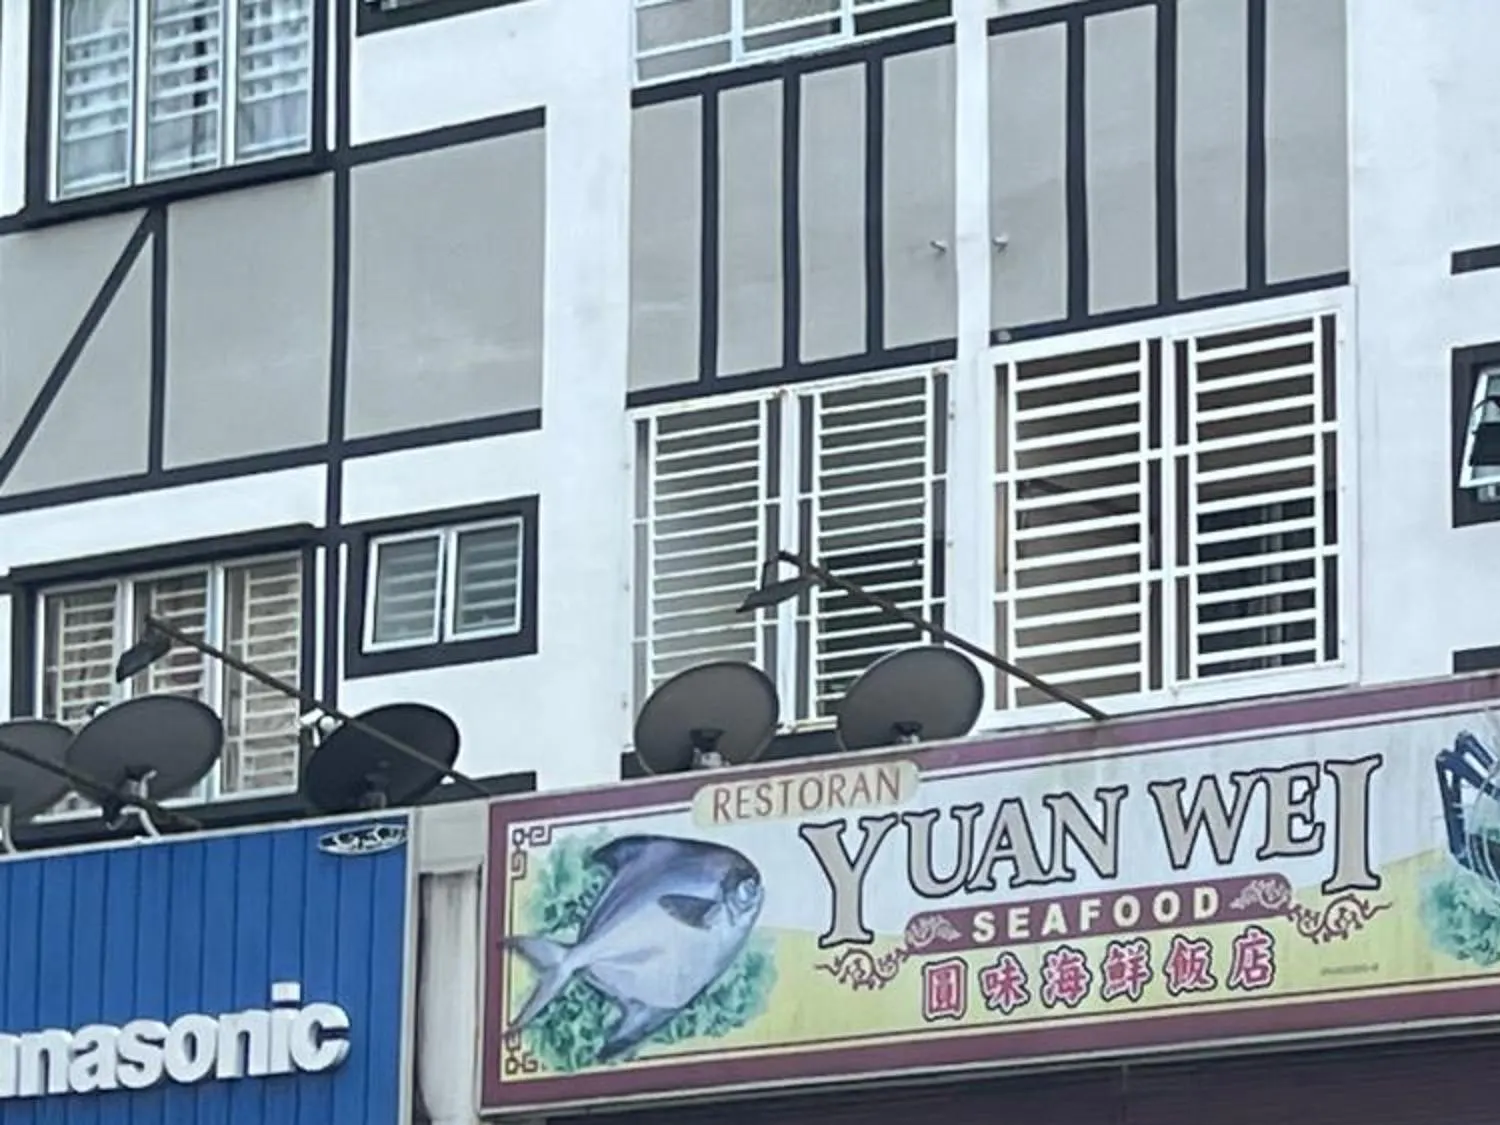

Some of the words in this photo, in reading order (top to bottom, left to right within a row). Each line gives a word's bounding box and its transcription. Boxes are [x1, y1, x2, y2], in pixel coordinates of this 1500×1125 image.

[712, 766, 904, 823] RESTORAN
[800, 785, 1128, 949] YUAN
[1149, 753, 1383, 894] WEI
[971, 886, 1220, 943] SEAFOOD
